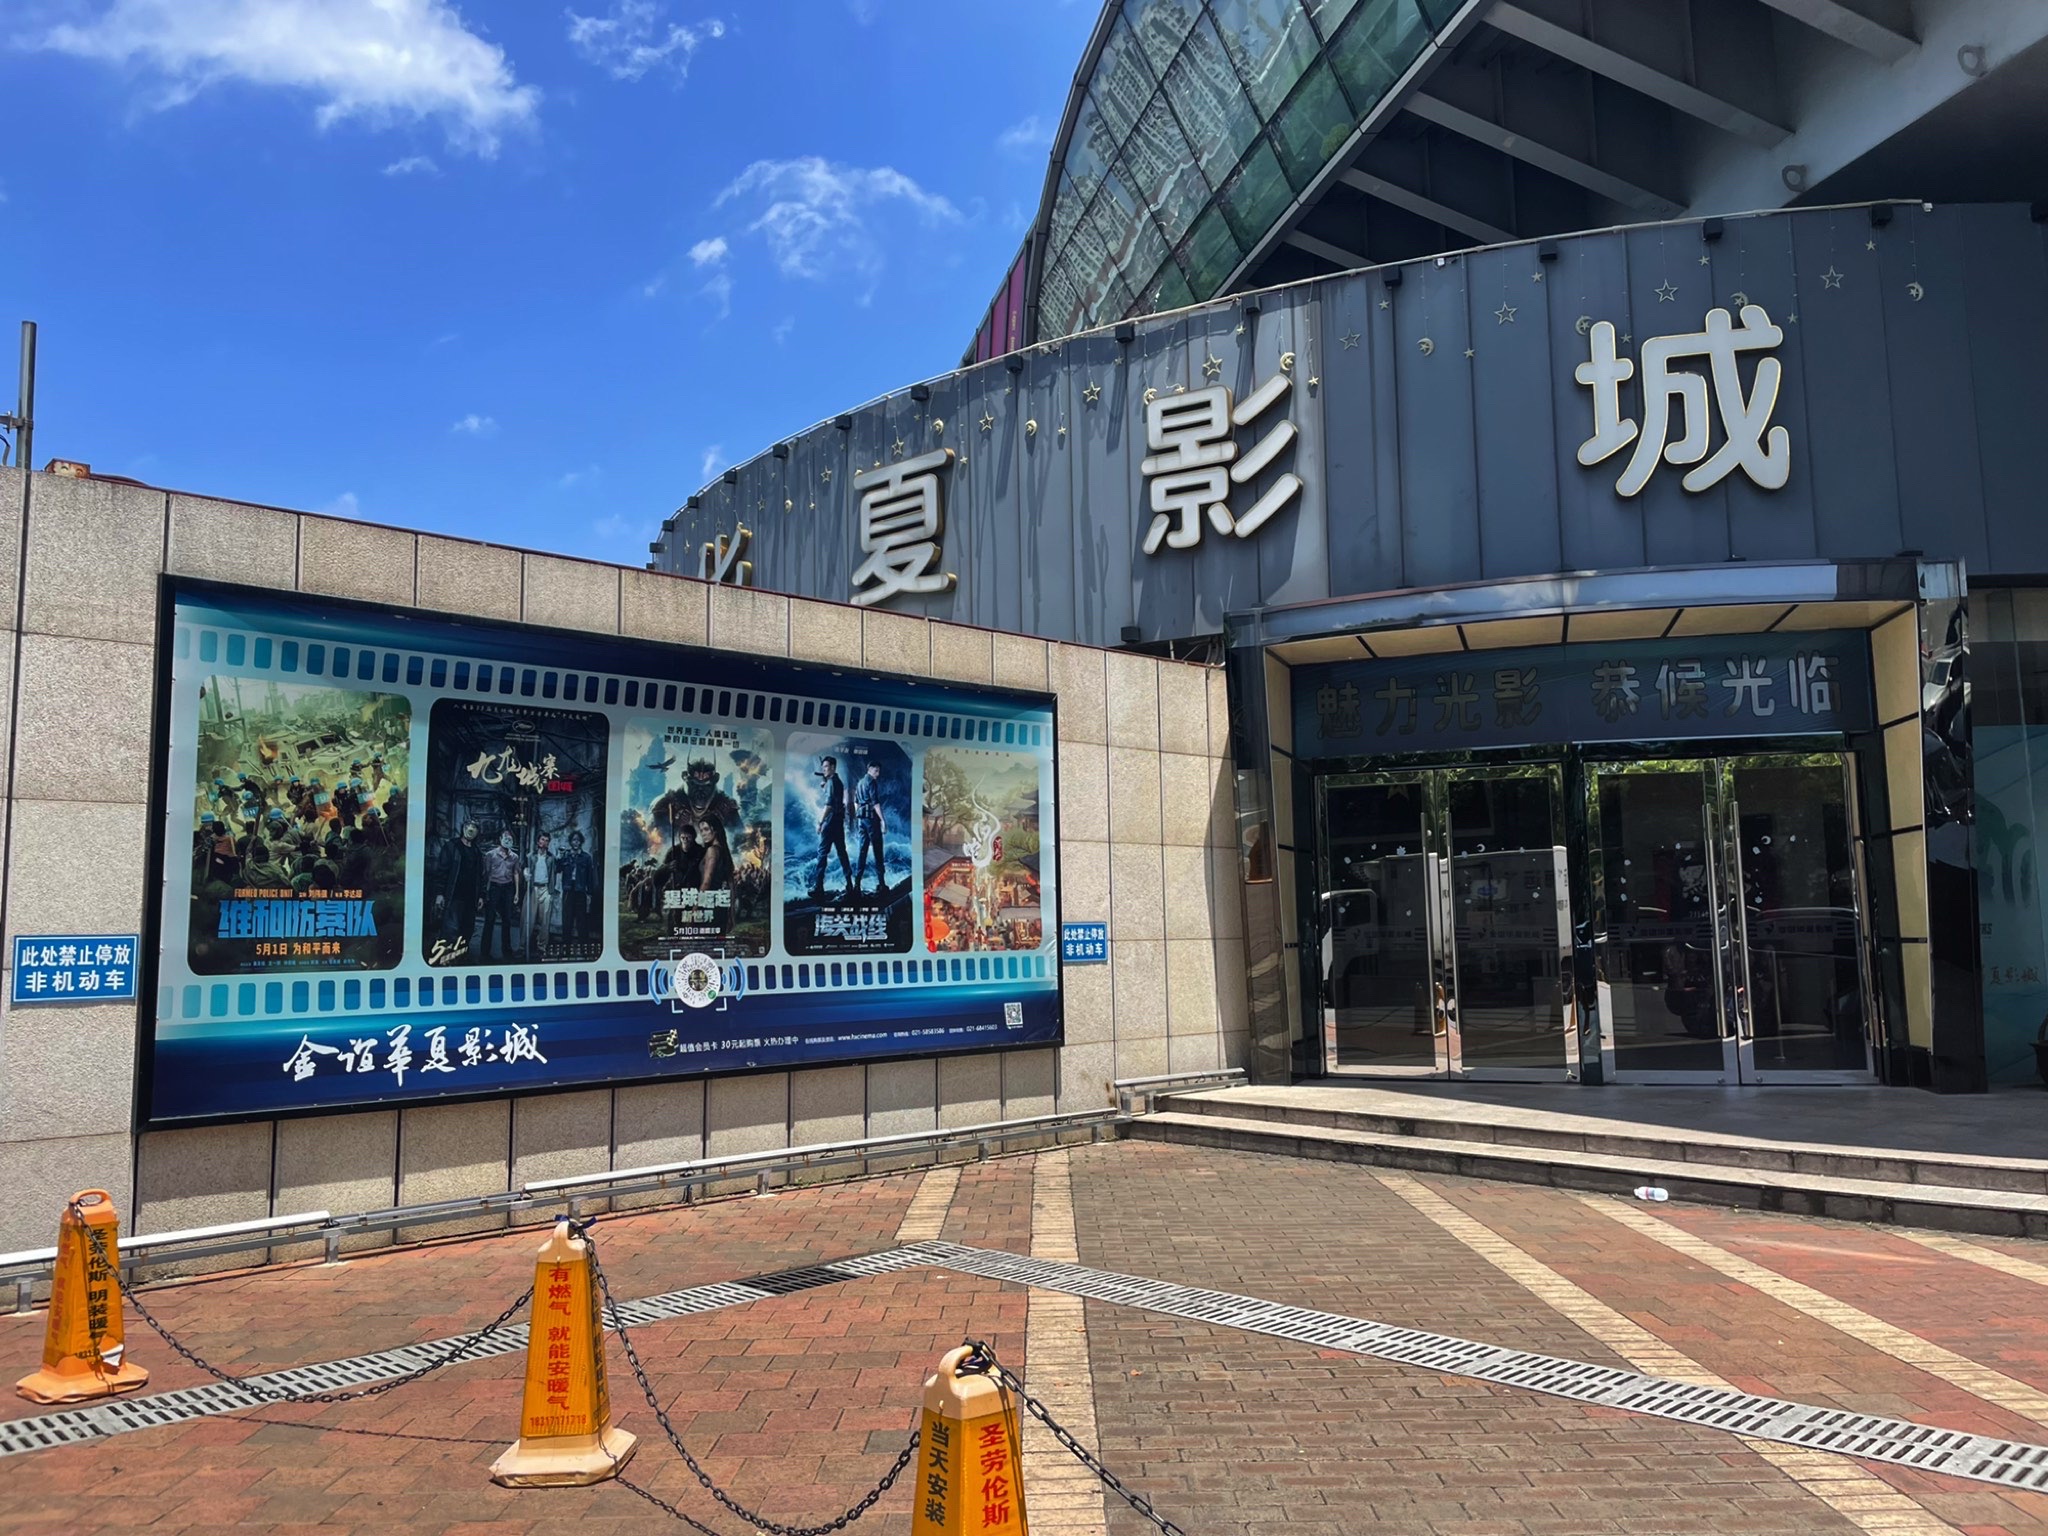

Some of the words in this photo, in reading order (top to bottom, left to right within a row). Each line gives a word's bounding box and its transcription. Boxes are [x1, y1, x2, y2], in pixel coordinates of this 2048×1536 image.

[1316, 666, 1542, 740] 魅力光影
[1590, 649, 1843, 724] 恭候光临
[259, 888, 279, 898] POLICE
[664, 887, 732, 909] 猩球崛起
[218, 900, 378, 938] 维和防暴队
[681, 909, 714, 922] 新世界
[814, 914, 888, 943] 海关战线
[1064, 927, 1104, 941] 此处禁止停放
[21, 944, 131, 967] 此处禁止停放
[256, 943, 288, 956] 5月1日
[293, 942, 341, 955] 为和平而来
[1066, 943, 1103, 956] 非机动车
[25, 969, 125, 992] 非机动车
[680, 1041, 718, 1053] 超值会员卡
[721, 1039, 761, 1050] 30元起购票
[764, 1036, 799, 1046] 火热办理中
[549, 1267, 571, 1316] 有燃气
[547, 1326, 571, 1410] 就能安暖气
[925, 1420, 949, 1527] 当天安装
[978, 1422, 1011, 1529] 圣劳伦斯
